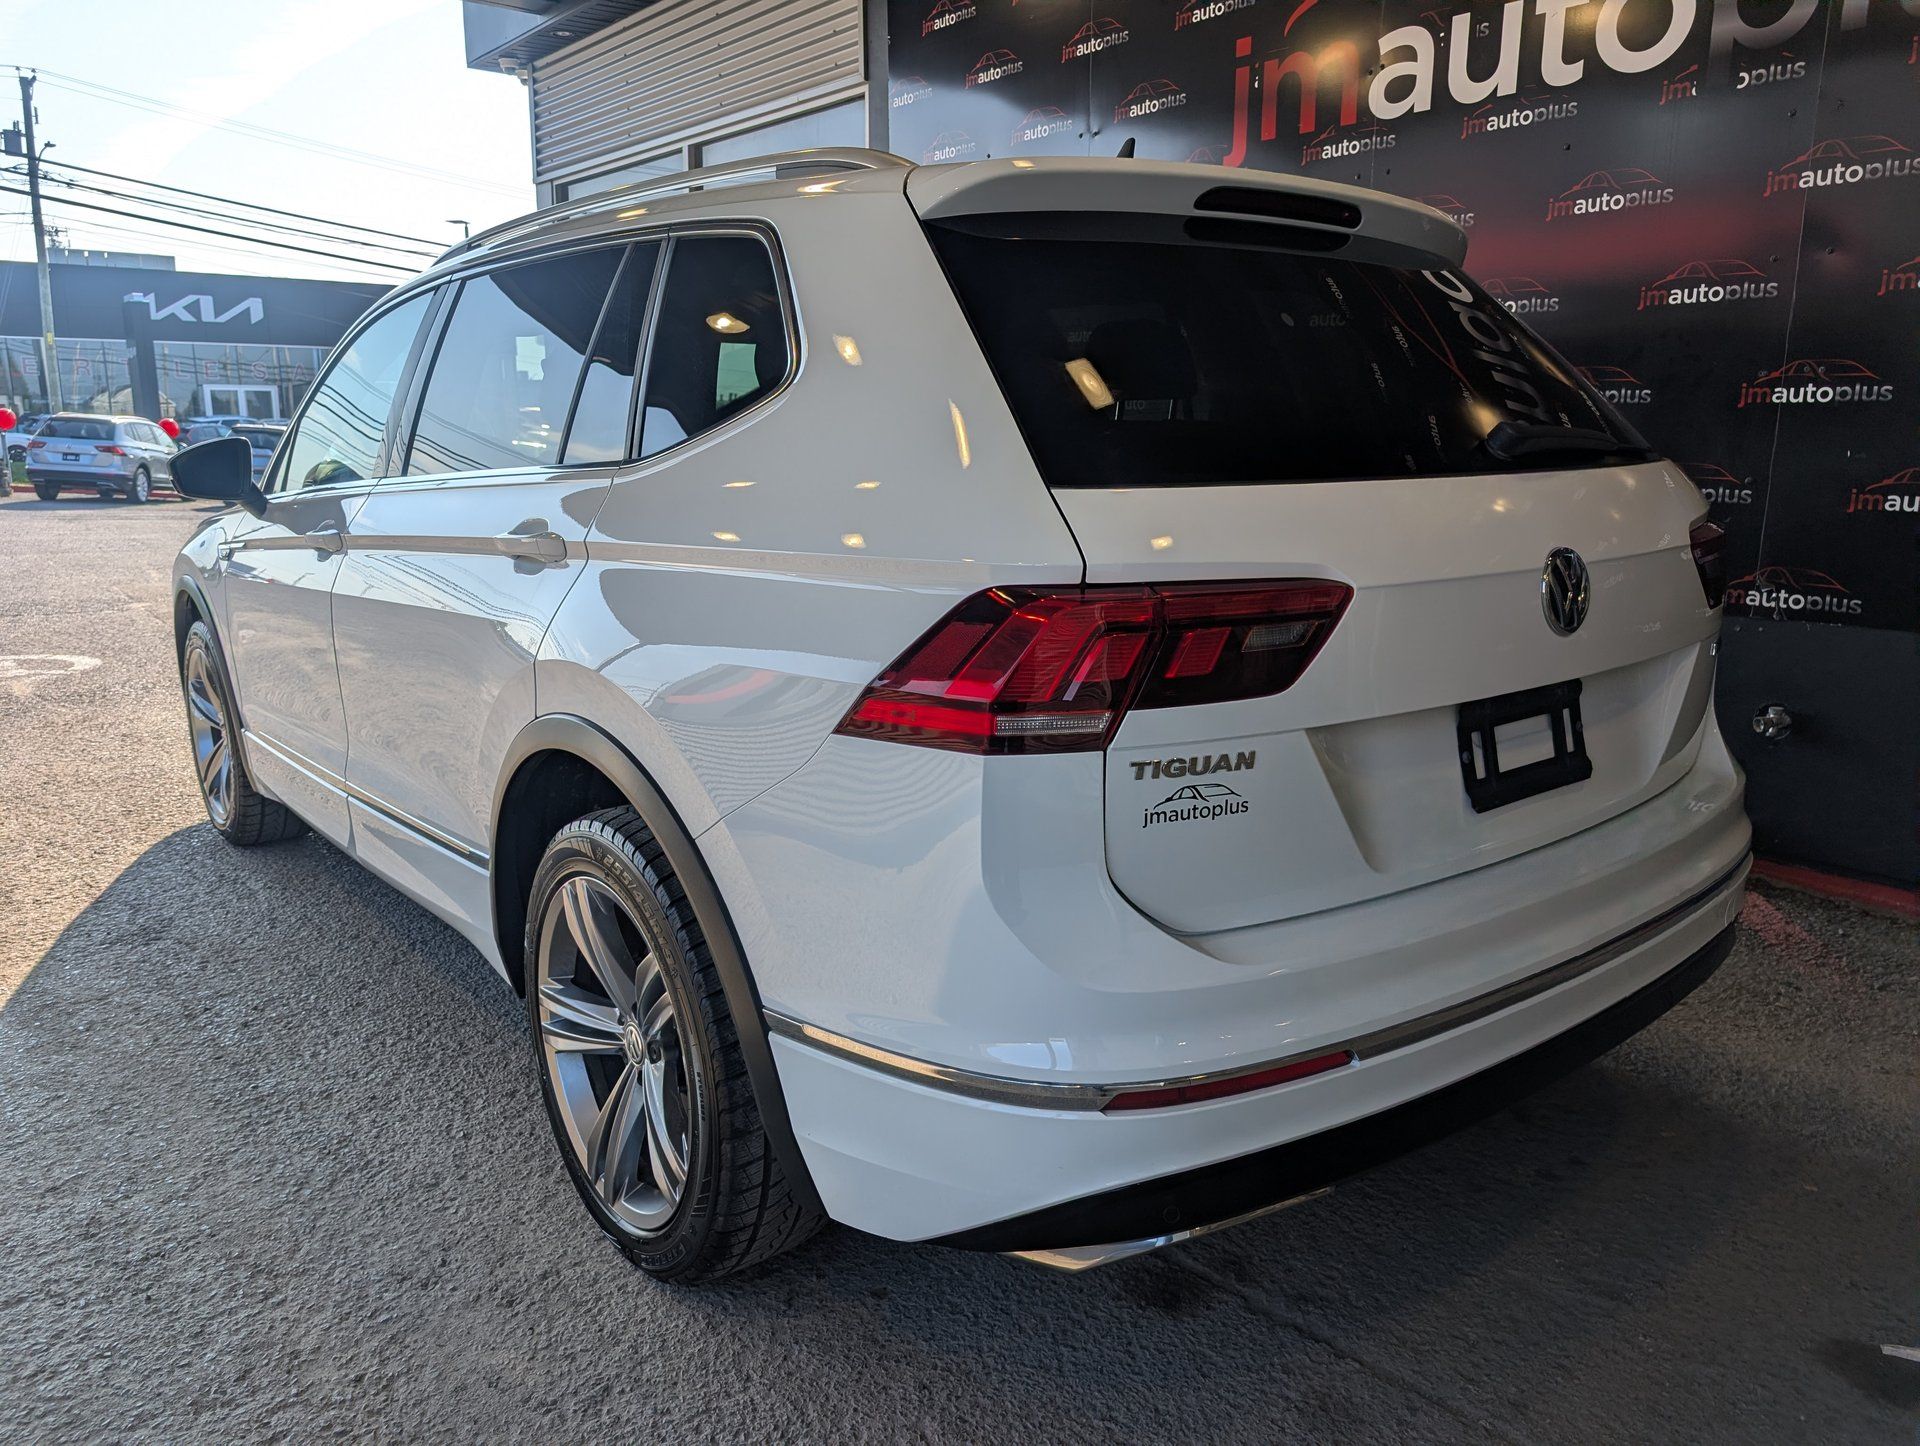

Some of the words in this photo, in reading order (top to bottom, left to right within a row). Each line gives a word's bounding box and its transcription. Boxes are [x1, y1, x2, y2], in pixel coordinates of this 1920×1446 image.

[921, 5, 977, 38] jmautoplus
[1061, 30, 1129, 64] jmautoplus
[964, 61, 1024, 90] jmautoplus
[1114, 92, 1187, 124] jmautoplus
[1461, 101, 1579, 140] jmautoplus
[1010, 119, 1073, 147] jmautoplus
[1301, 133, 1396, 167] jmautoplus
[1763, 157, 1920, 197] jmautoplus
[1545, 187, 1674, 223] jmautoplus
[1637, 281, 1779, 312] jmautoplus
[1736, 383, 1894, 409] jmautoplus
[1129, 750, 1256, 781] TIGUAN
[1142, 799, 1249, 829] jmautoplus
